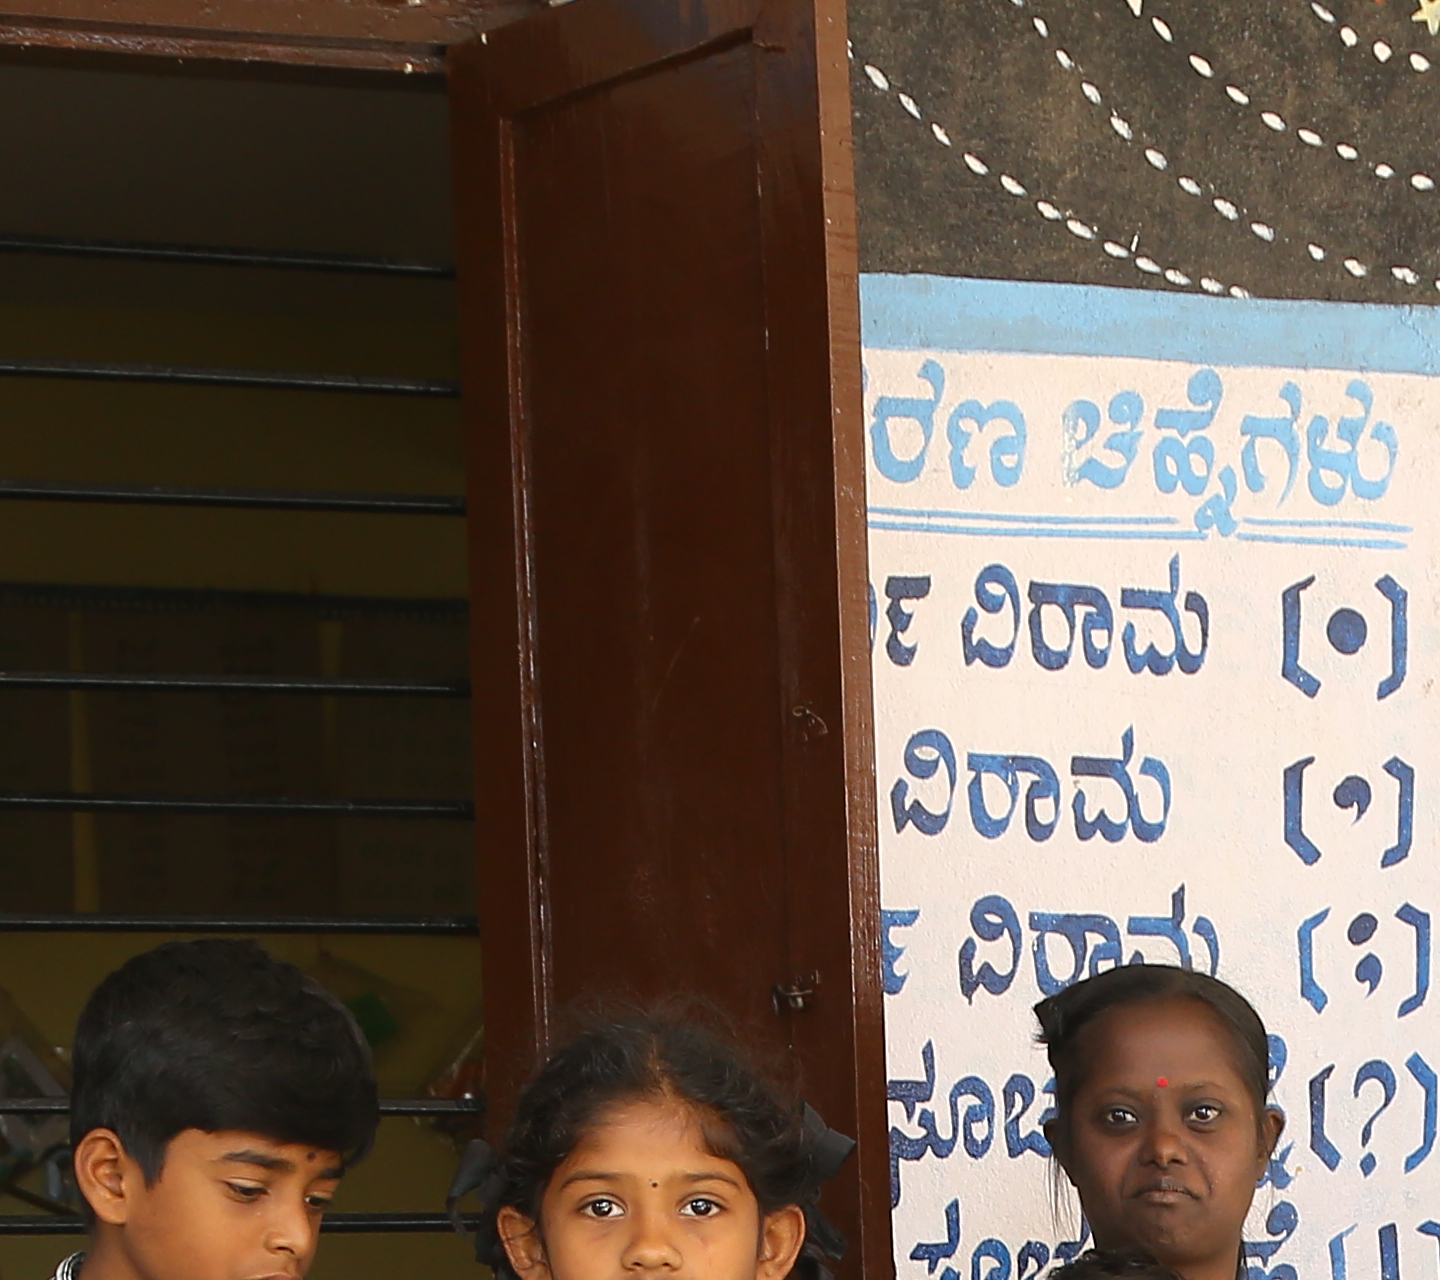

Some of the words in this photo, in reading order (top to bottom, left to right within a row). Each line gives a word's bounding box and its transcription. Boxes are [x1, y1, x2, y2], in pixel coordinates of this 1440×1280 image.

[862, 358, 1028, 490] ರಣ
[961, 552, 1210, 676] ವಿರಾಮ
[890, 723, 1172, 843] ವಿರಾಮ
